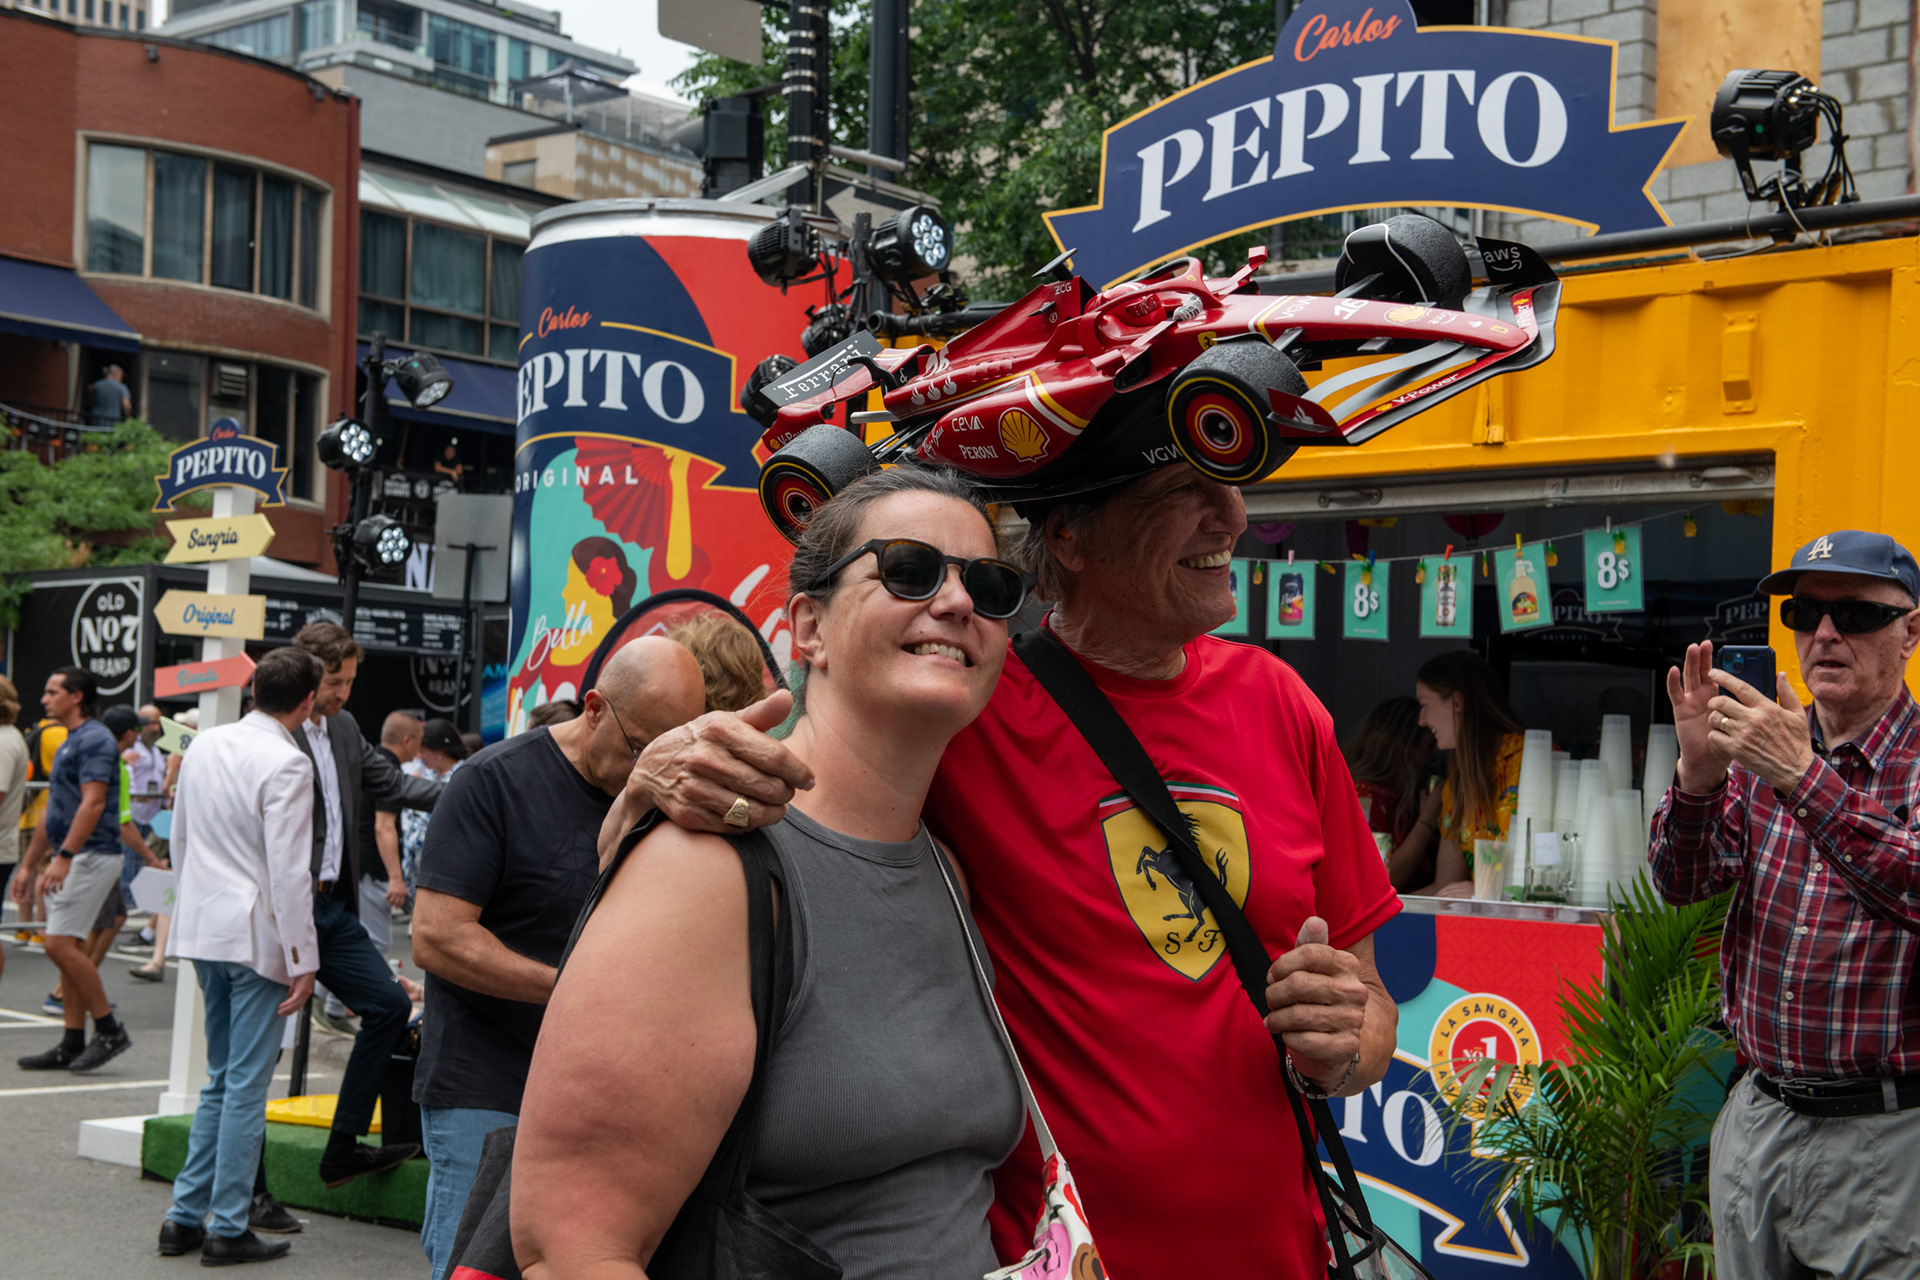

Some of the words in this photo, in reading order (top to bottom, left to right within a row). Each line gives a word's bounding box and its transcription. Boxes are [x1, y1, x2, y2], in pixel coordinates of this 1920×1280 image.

[1294, 7, 1402, 62] Carlos
[1132, 70, 1568, 233] PEPITO
[1483, 246, 1521, 263] aws
[538, 305, 592, 338] Carlos
[1333, 298, 1370, 320] 16
[777, 344, 864, 399] Ferrari
[1391, 373, 1459, 403] V-Power
[174, 446, 266, 487] PEPITO
[515, 465, 638, 493] ORIGINAL
[187, 526, 238, 554] Sangria
[1597, 551, 1630, 589] 8$
[97, 592, 126, 611] OLD
[1353, 583, 1379, 618] 8$
[183, 603, 235, 630] Original
[527, 600, 593, 671] Bella
[89, 657, 131, 677] BRAND
[1165, 931, 1181, 955] S
[1198, 929, 1223, 953] F
[1440, 1018, 1457, 1038] LA
[1462, 1003, 1530, 1047] SANGRIA
